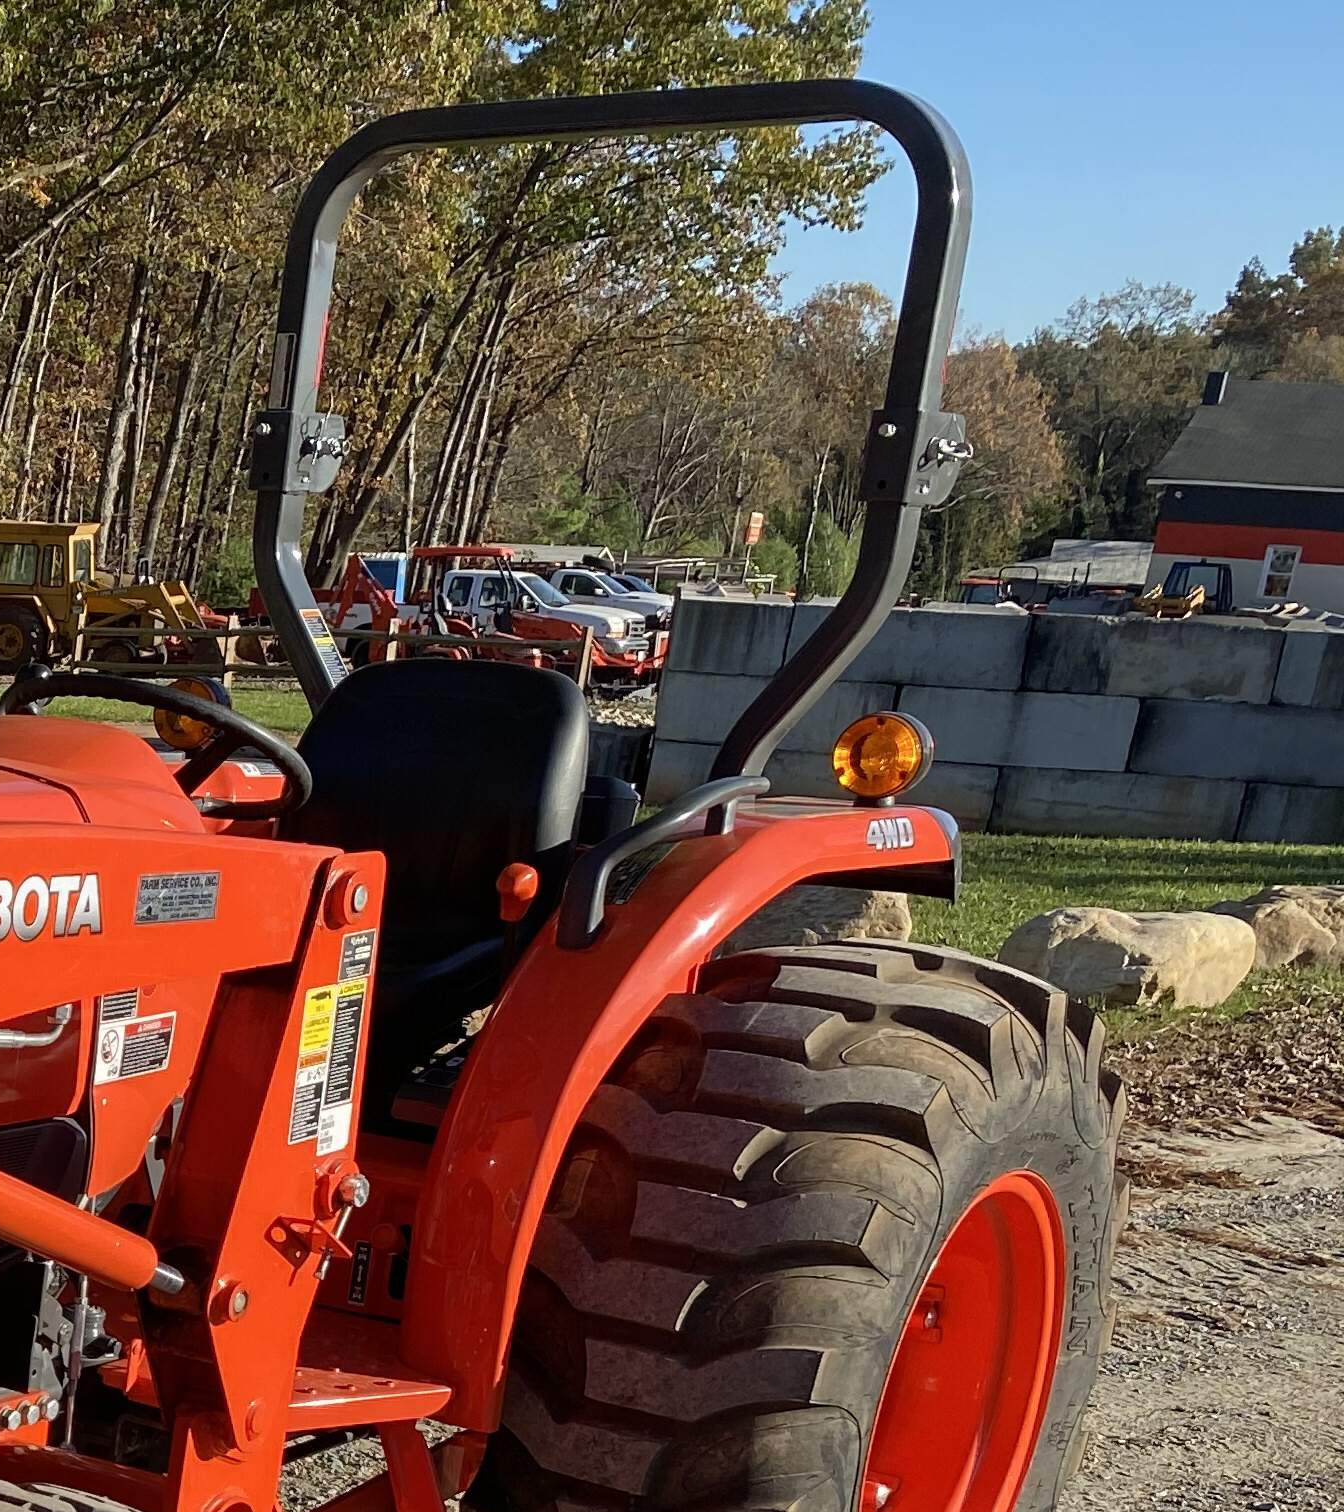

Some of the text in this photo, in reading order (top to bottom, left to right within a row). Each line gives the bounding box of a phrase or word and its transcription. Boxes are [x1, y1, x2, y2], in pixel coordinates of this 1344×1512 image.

[866, 817, 915, 851] 4WD
[140, 879, 160, 890] FARM
[161, 877, 189, 889] SERVICE
